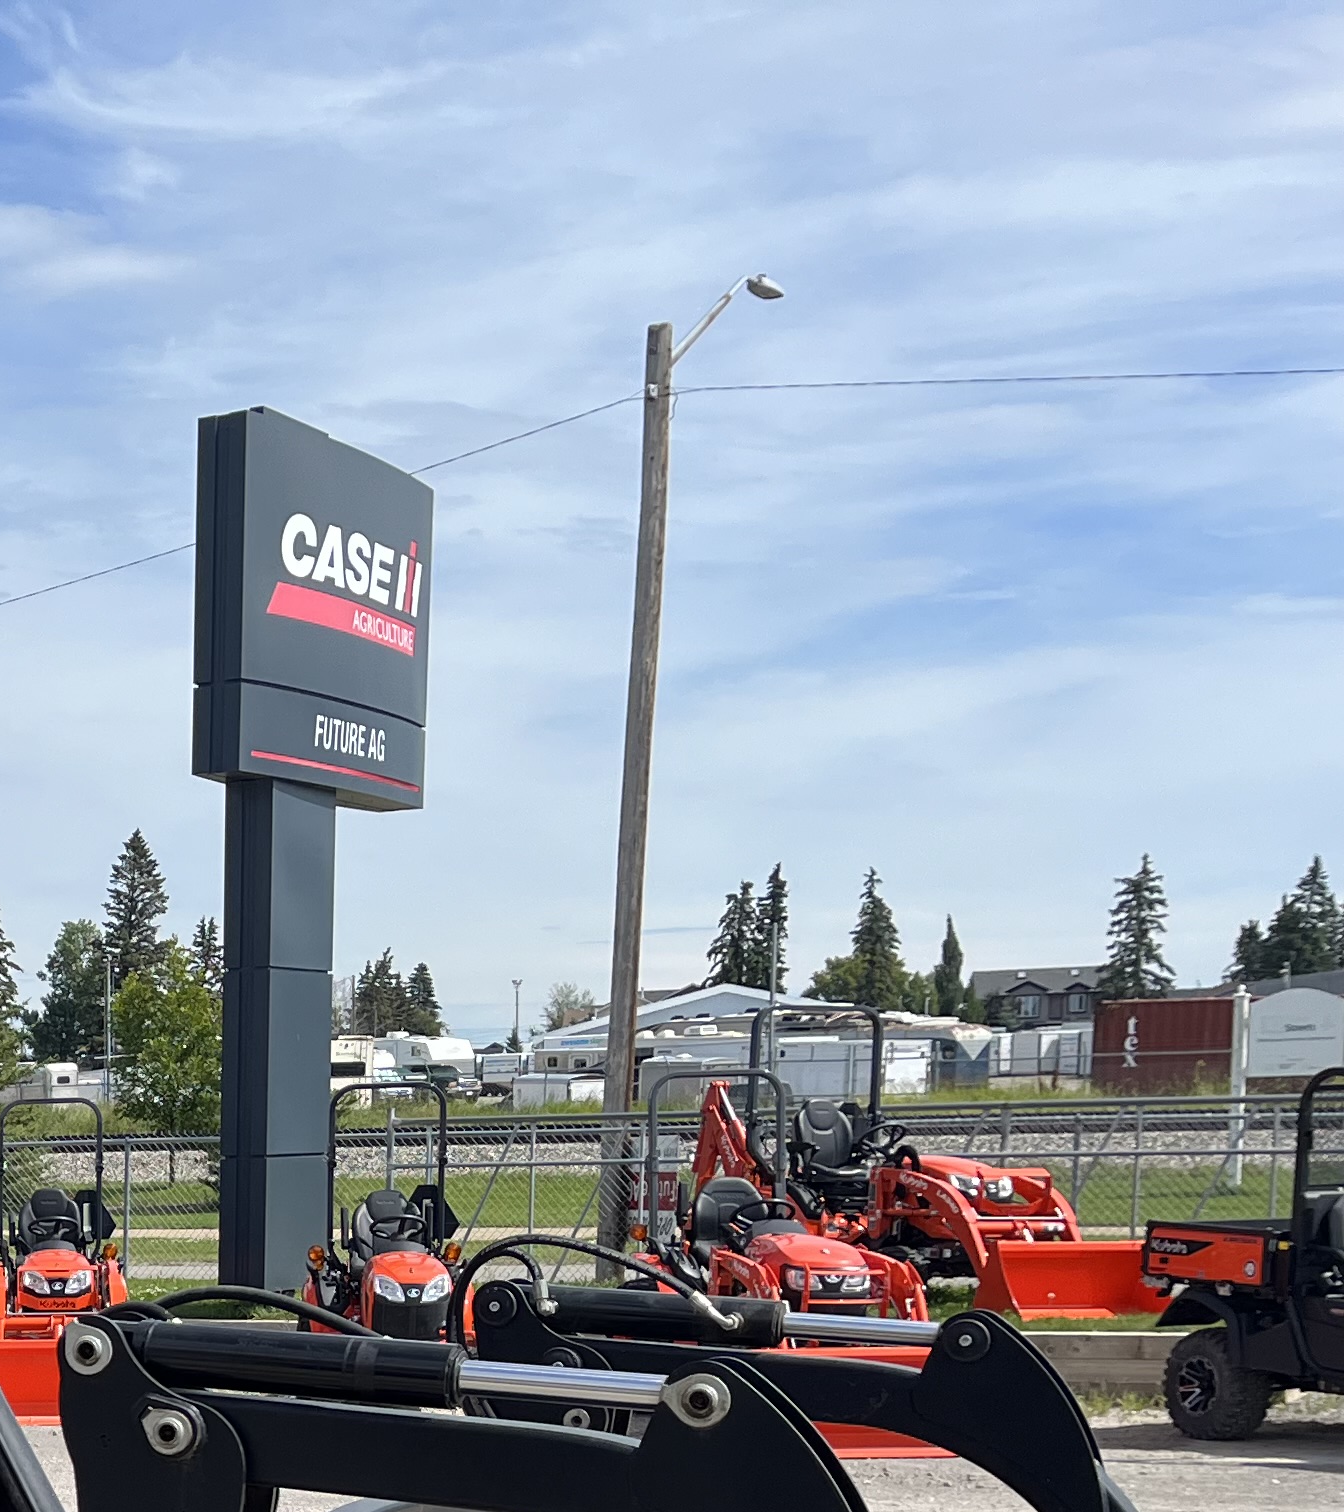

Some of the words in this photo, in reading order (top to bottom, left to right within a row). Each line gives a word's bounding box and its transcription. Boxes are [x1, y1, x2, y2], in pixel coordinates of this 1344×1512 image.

[281, 513, 395, 605] CASE
[352, 610, 414, 650] AGRICULTURE
[314, 714, 366, 757] FUTURE
[367, 727, 386, 762] AG
[39, 1300, 76, 1308] Kubota
